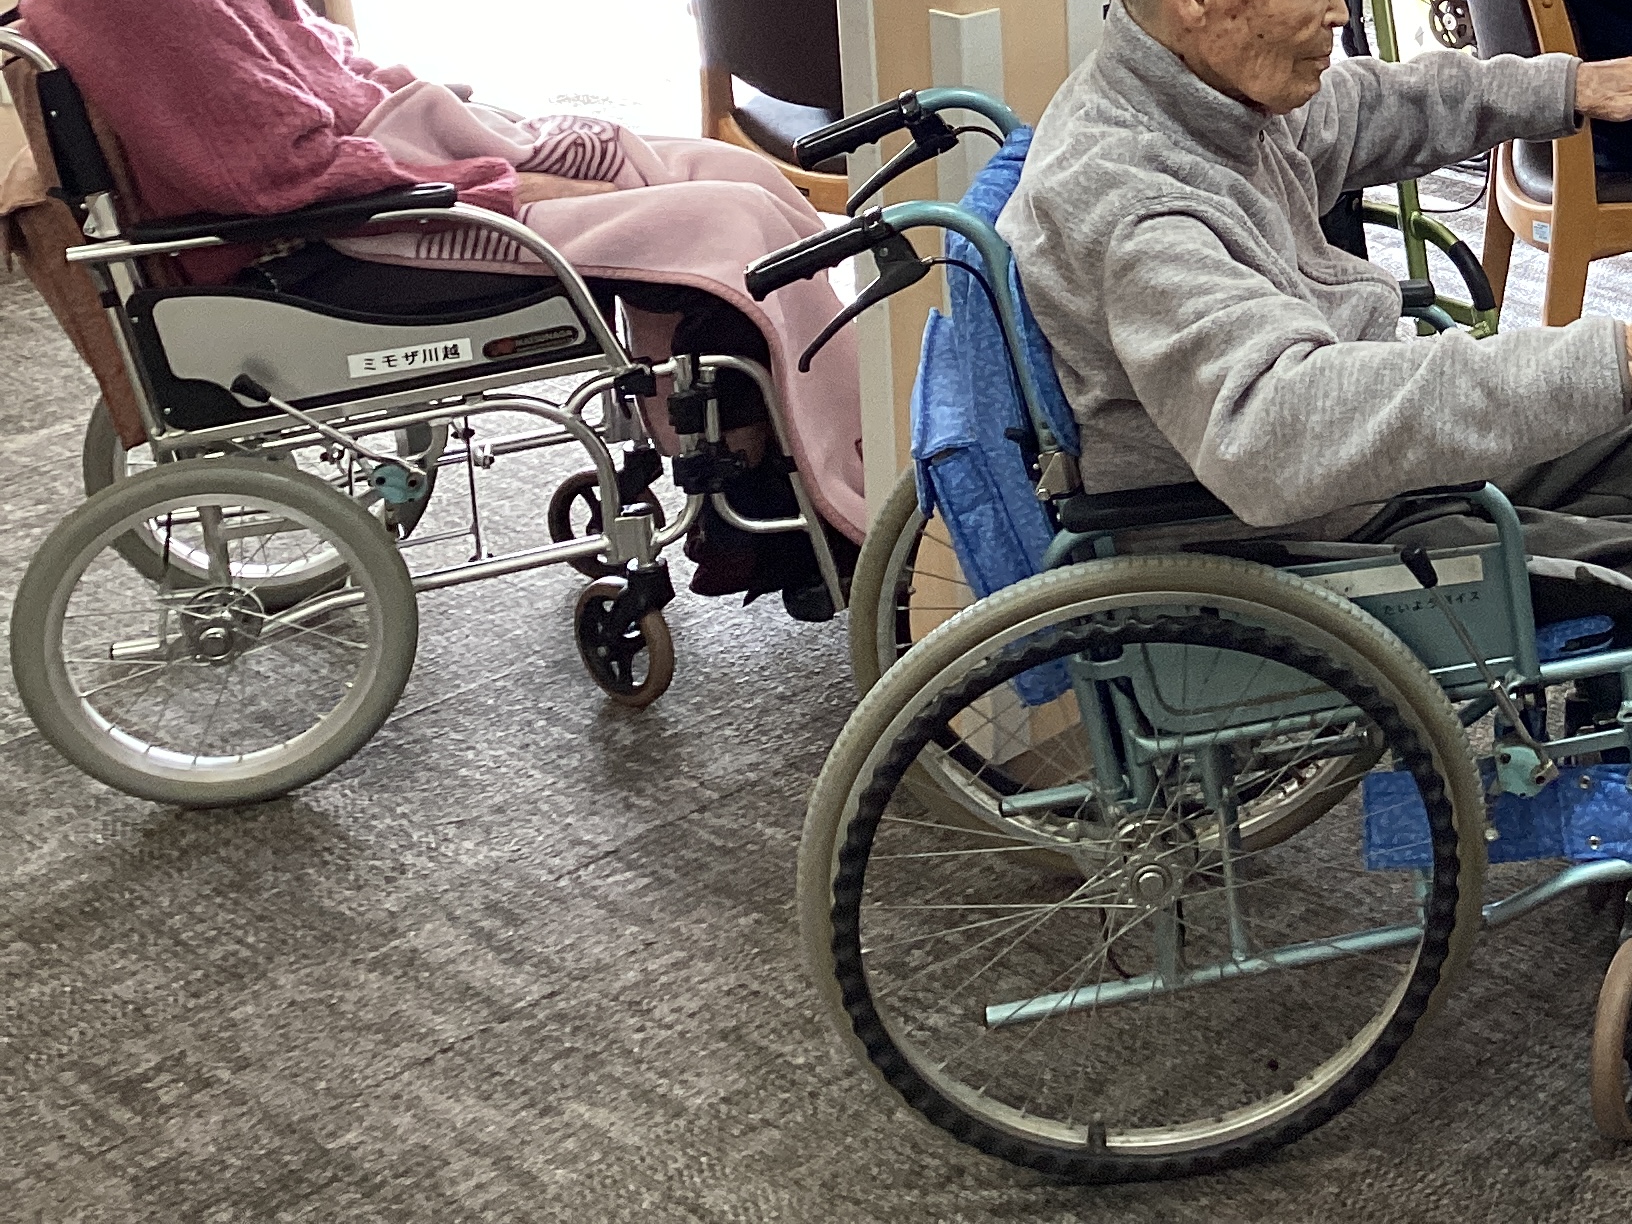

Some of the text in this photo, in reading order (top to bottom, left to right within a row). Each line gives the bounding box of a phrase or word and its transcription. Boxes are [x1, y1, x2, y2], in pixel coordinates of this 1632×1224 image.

[363, 343, 460, 371] ミモザ川越
